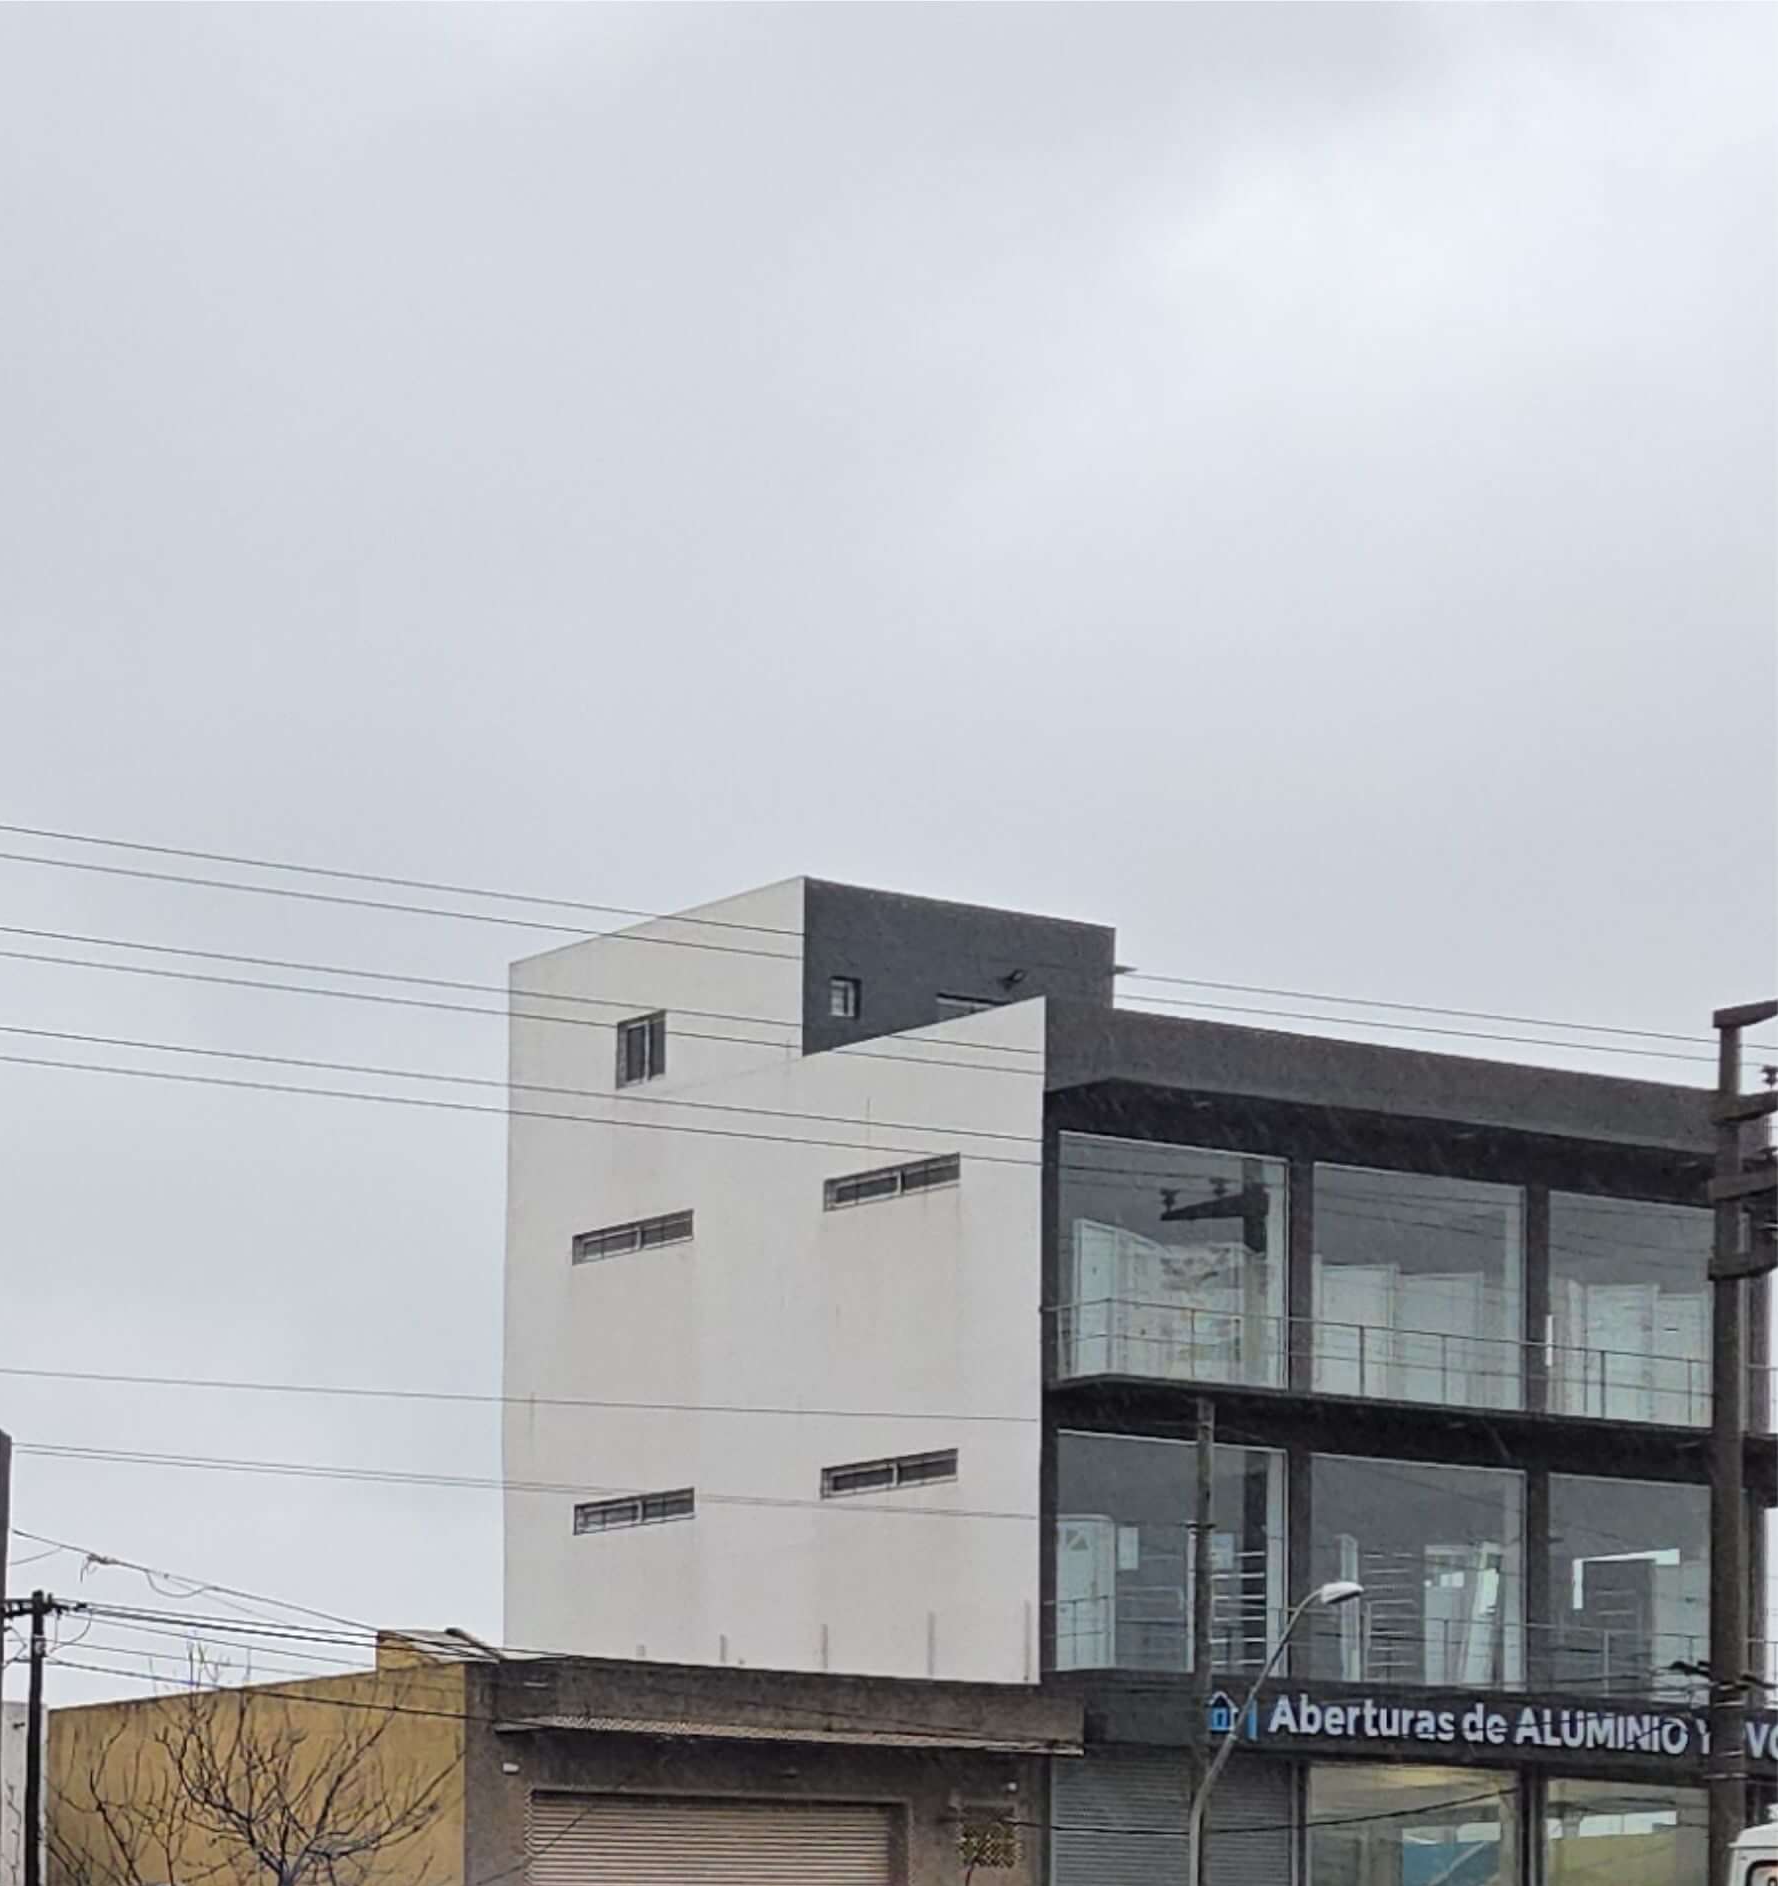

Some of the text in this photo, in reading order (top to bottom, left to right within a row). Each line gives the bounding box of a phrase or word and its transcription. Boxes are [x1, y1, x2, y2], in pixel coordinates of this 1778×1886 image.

[1267, 1693, 1455, 1742] Aberturas
[1462, 1702, 1509, 1744] de
[1514, 1706, 1689, 1755] ALUMINIO
